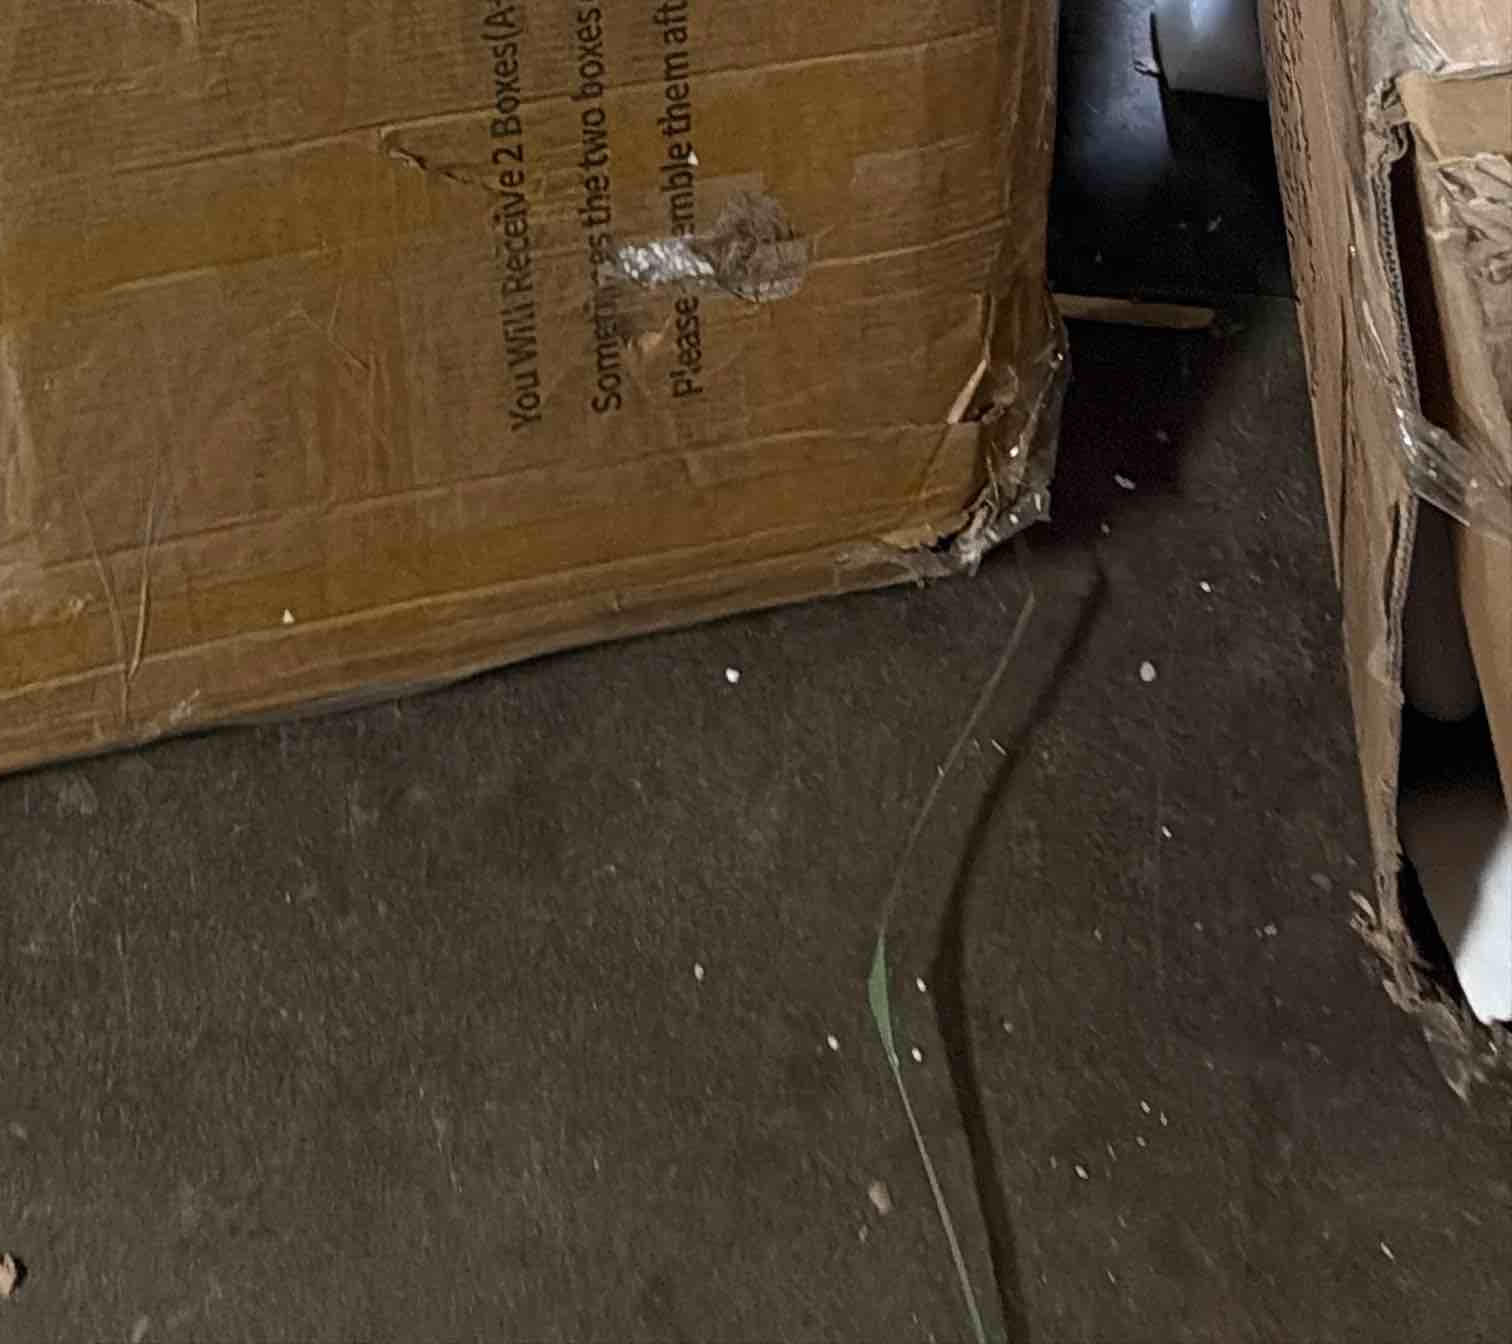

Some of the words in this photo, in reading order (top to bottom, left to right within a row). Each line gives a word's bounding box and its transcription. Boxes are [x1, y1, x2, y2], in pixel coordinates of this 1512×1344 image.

[571, 9, 604, 100] boxes
[655, 52, 692, 137] them
[493, 145, 522, 164] 2
[580, 107, 607, 168] two
[493, 170, 534, 294] Receive
[578, 175, 609, 226] the
[503, 304, 537, 367] Will
[670, 297, 704, 398] Please
[506, 371, 542, 431] You
